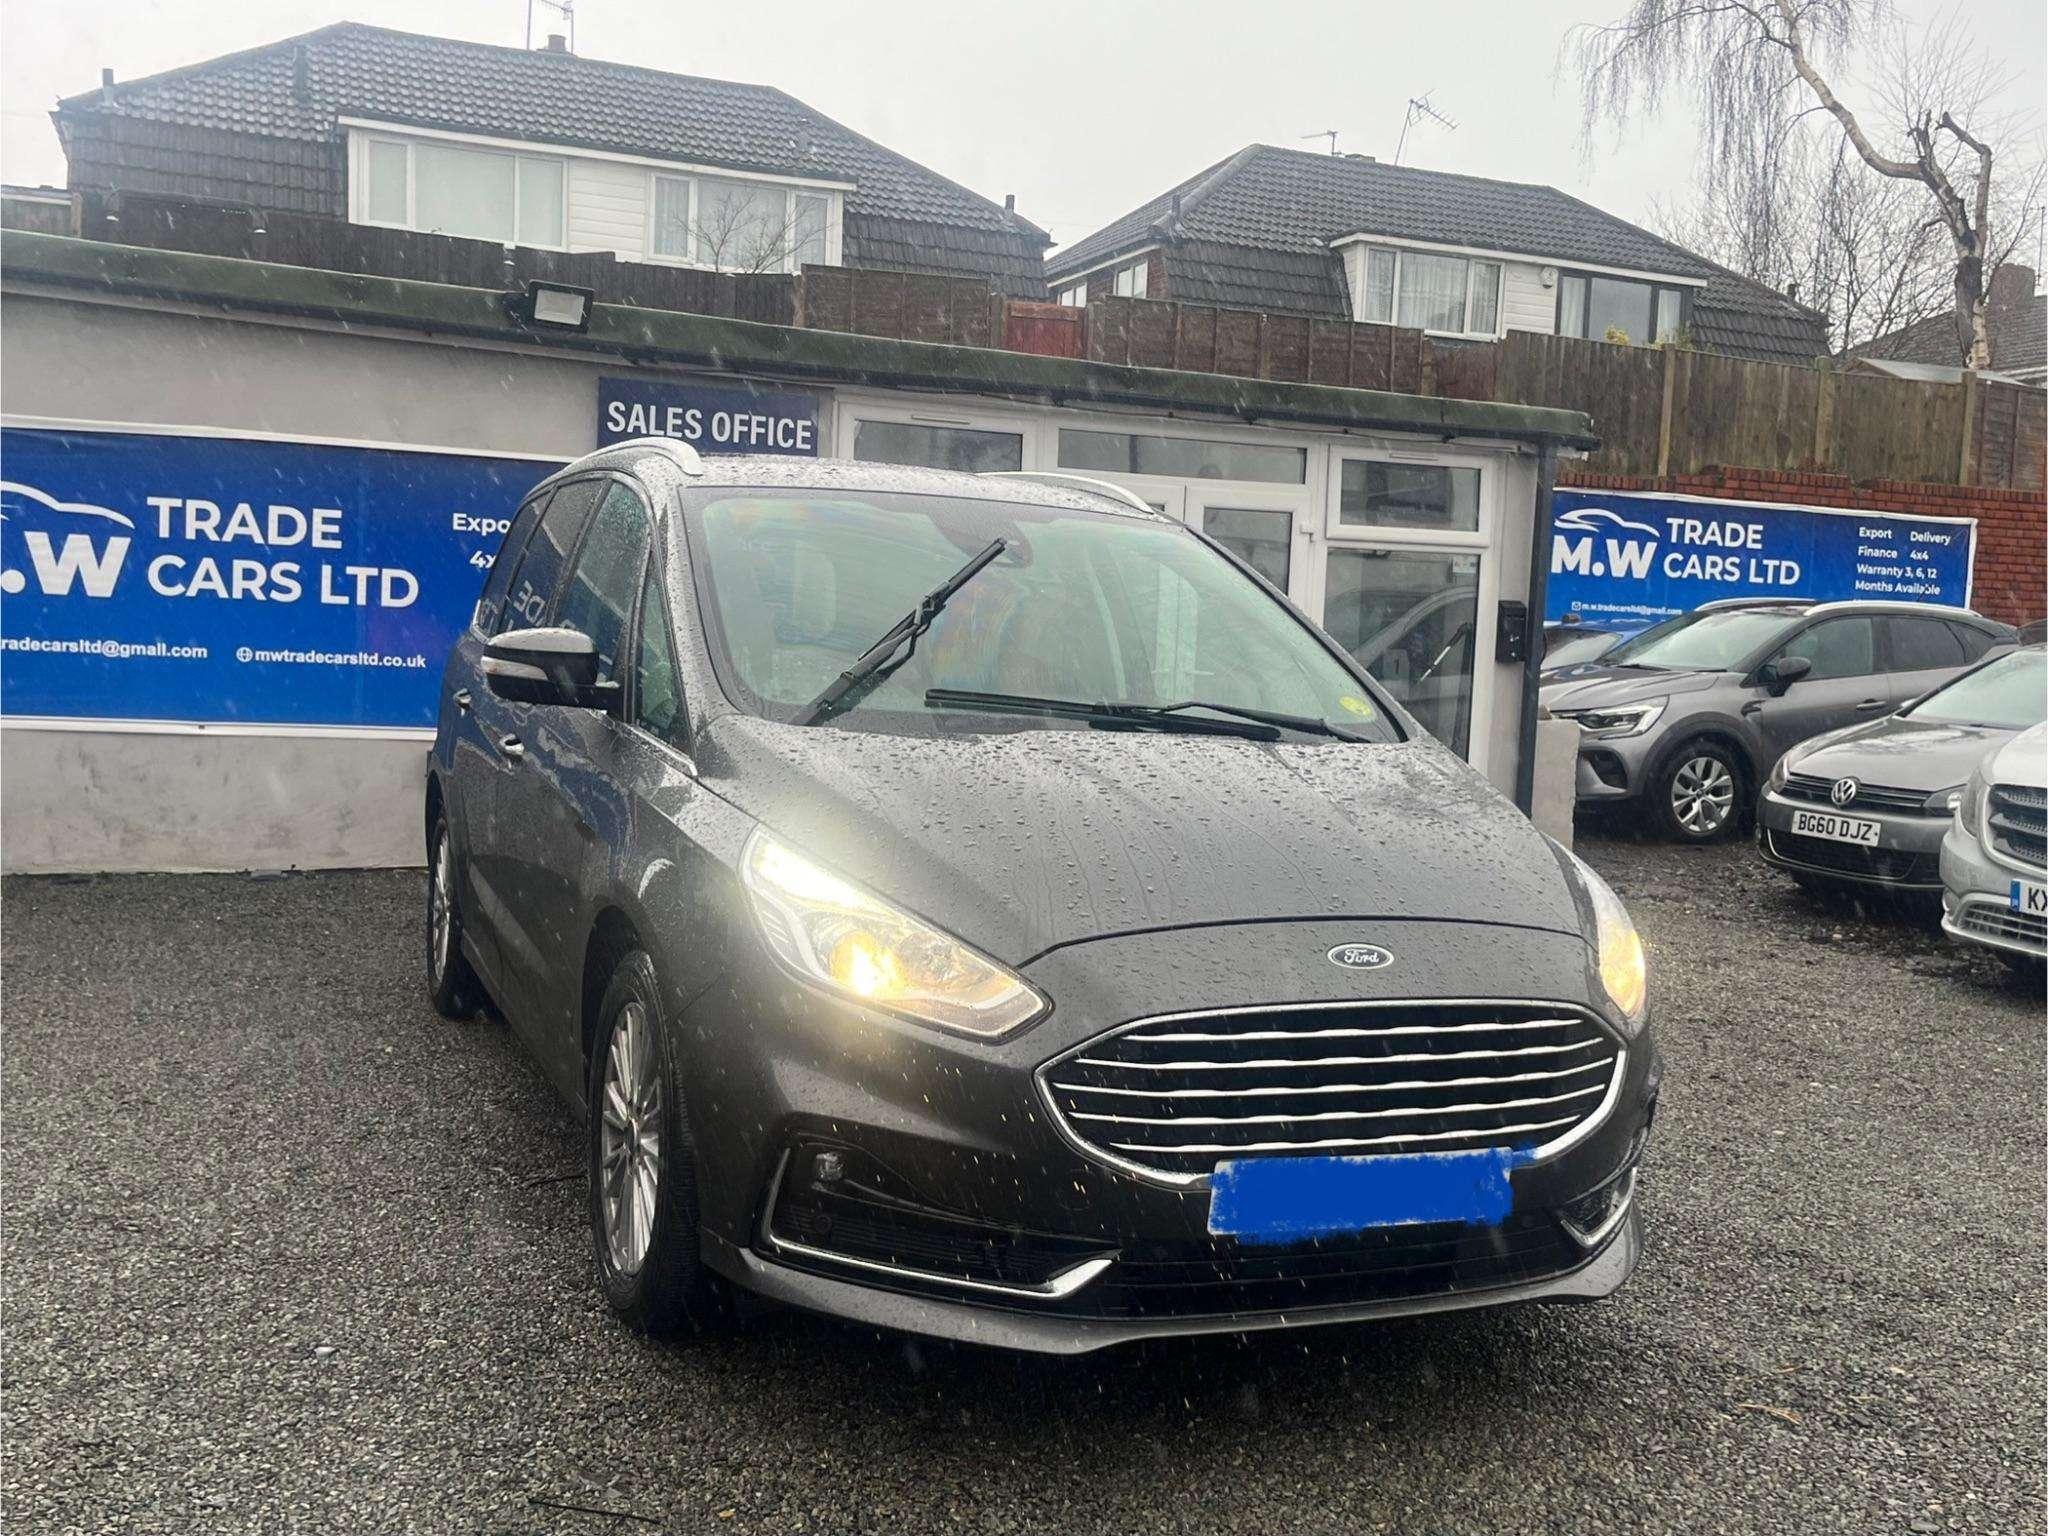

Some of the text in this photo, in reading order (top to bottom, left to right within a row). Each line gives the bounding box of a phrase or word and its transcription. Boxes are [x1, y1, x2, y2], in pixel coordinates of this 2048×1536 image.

[606, 401, 813, 450] SALES OFFICE
[147, 496, 344, 550] TRADE
[1859, 526, 1893, 540] Export
[1666, 518, 1764, 549] TRADE
[1909, 531, 1952, 546] Delivery
[1550, 534, 1658, 580] M.W
[1857, 545, 1898, 559] Finance
[1909, 550, 1929, 561] 4x4
[1663, 553, 1801, 586] CARS LTD
[1856, 563, 1903, 578] Warranty
[1927, 568, 1938, 579] 12
[147, 555, 420, 608] CARS LTD
[1854, 580, 1893, 593] Months
[254, 648, 427, 668] mwtradecarsltd.co.uk
[1797, 813, 1873, 841] BG60 DJZ
[1343, 948, 1380, 963] Ford
